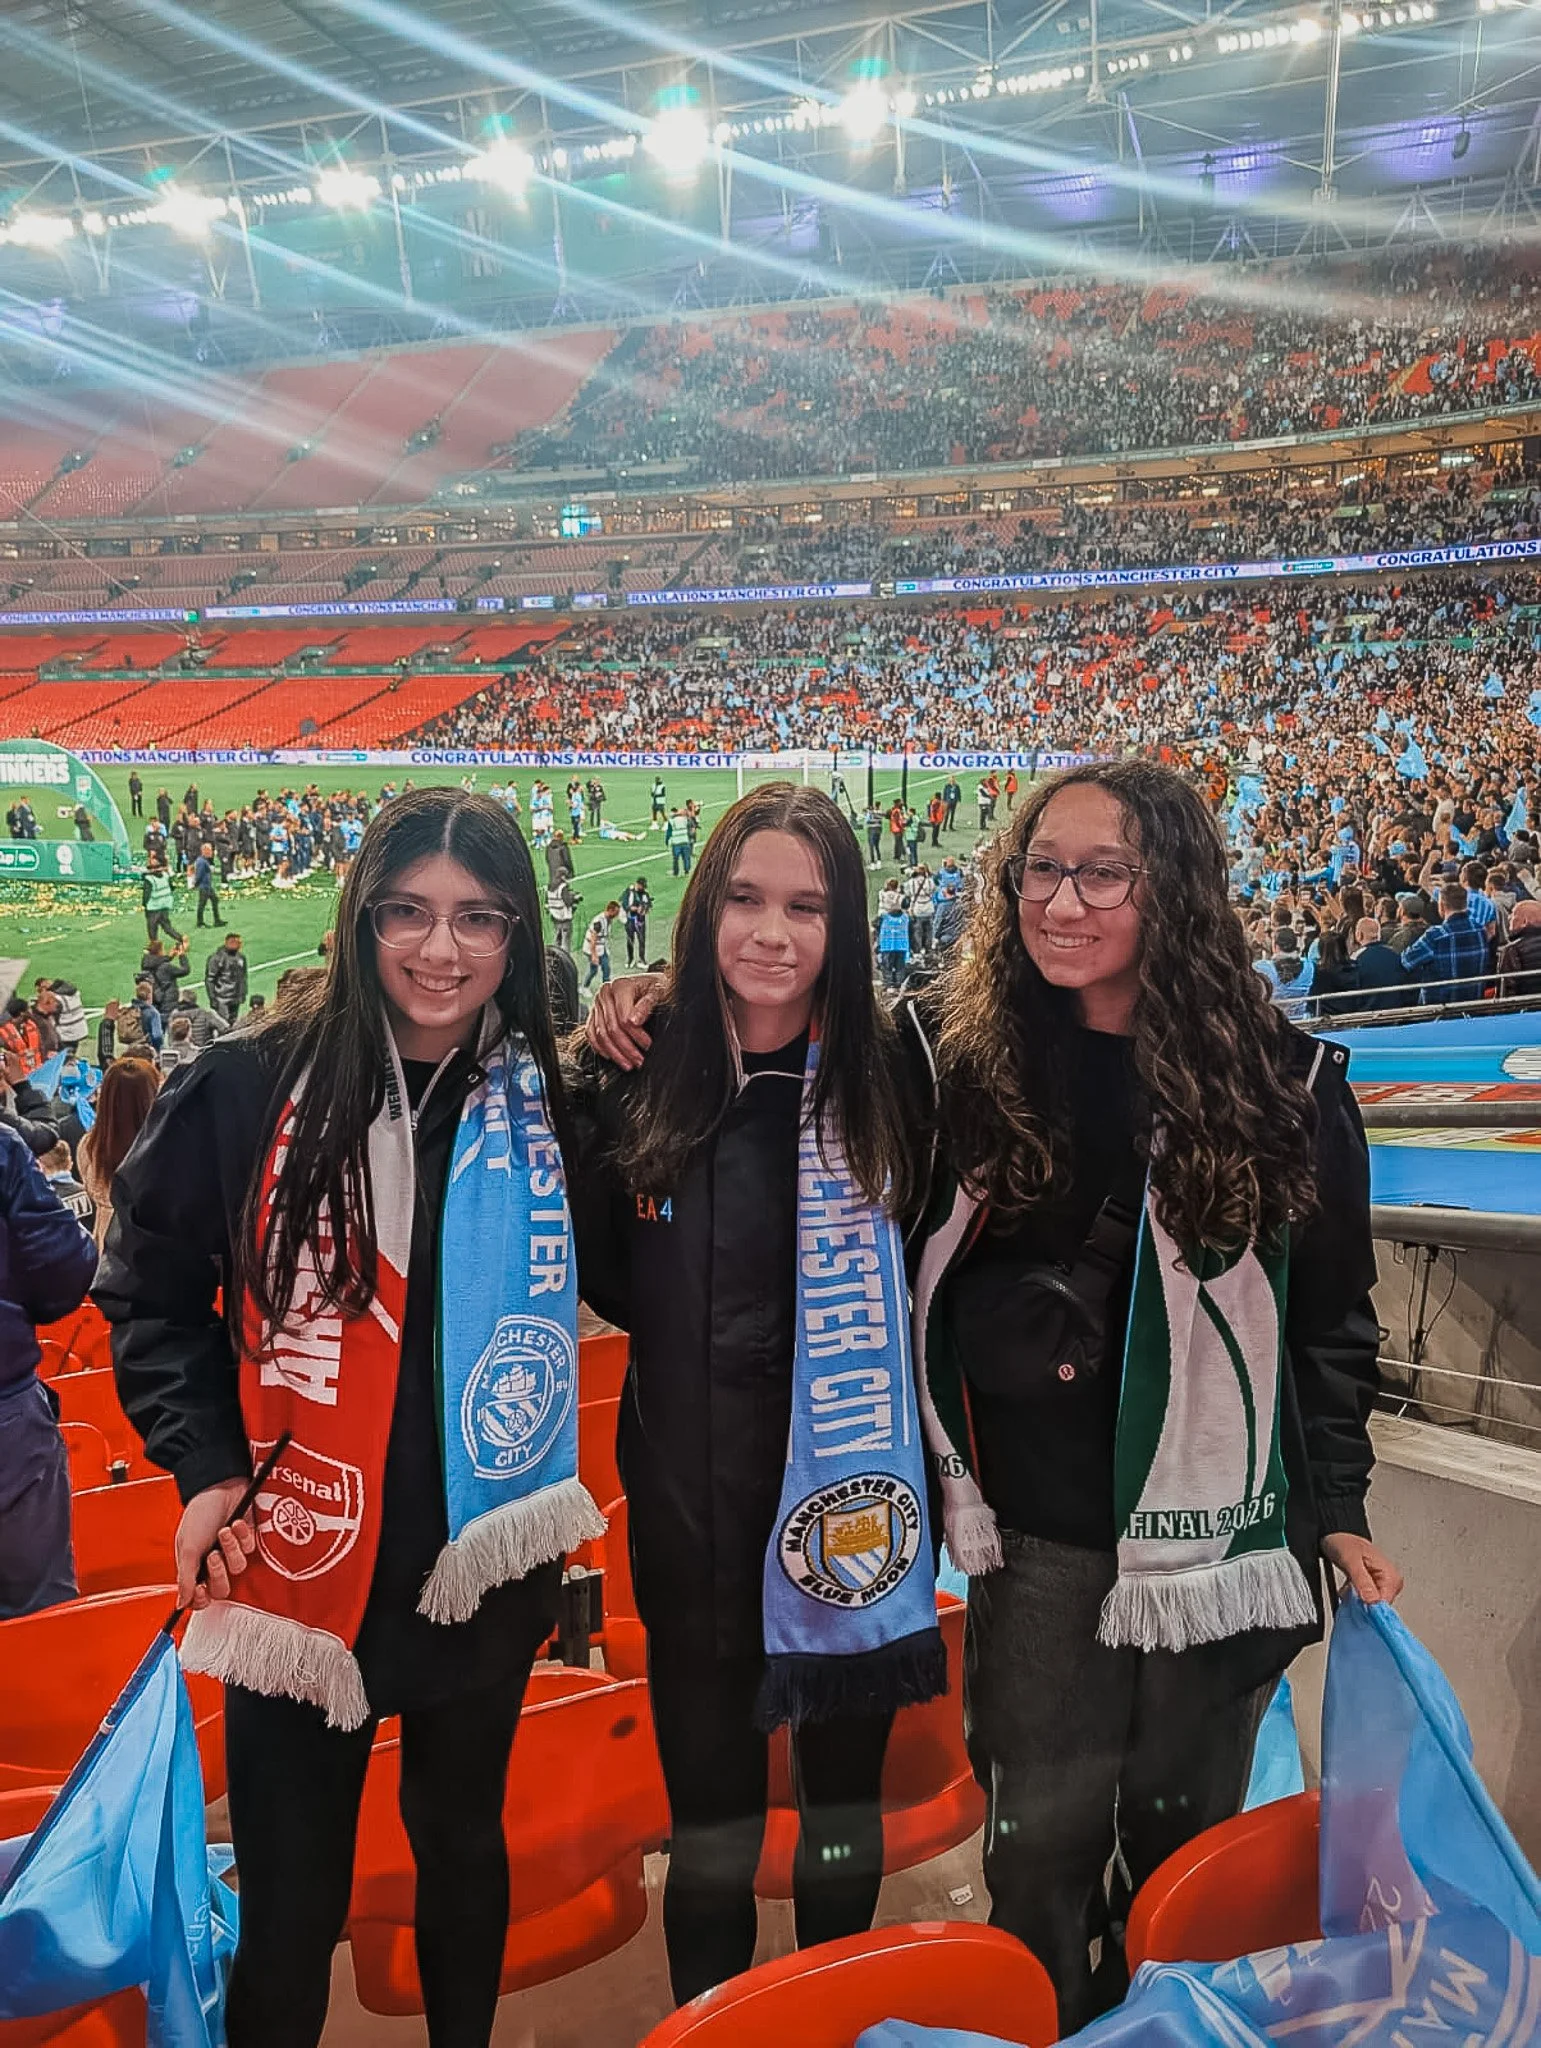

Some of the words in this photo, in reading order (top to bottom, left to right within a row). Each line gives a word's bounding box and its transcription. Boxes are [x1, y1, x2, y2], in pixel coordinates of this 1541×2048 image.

[1377, 542, 1537, 567] CONGRATULATIONS
[953, 574, 1093, 590] CONGRATULATIONS
[1095, 569, 1201, 585] MANCHESTER
[1203, 566, 1240, 577] CITY
[394, 600, 457, 612] MANCHEST
[630, 591, 715, 604] RATULATIONS
[717, 588, 805, 600] MANCHESTER
[807, 586, 838, 597] CITY
[80, 751, 132, 762] ATIONS
[134, 751, 237, 763] MANCHESTER
[411, 752, 573, 765] CONGRATULATIONS
[576, 753, 701, 767] MANCHESTER
[0, 762, 70, 784] INNERS
[809, 1367, 894, 1458] CITY
[494, 1442, 534, 1467] CITY
[785, 1478, 898, 1552] MANCHESTER
[896, 1492, 919, 1531] CITY
[1128, 1510, 1213, 1539] FINAL
[798, 1573, 855, 1605] BLUE
[860, 1557, 910, 1604] MOON
